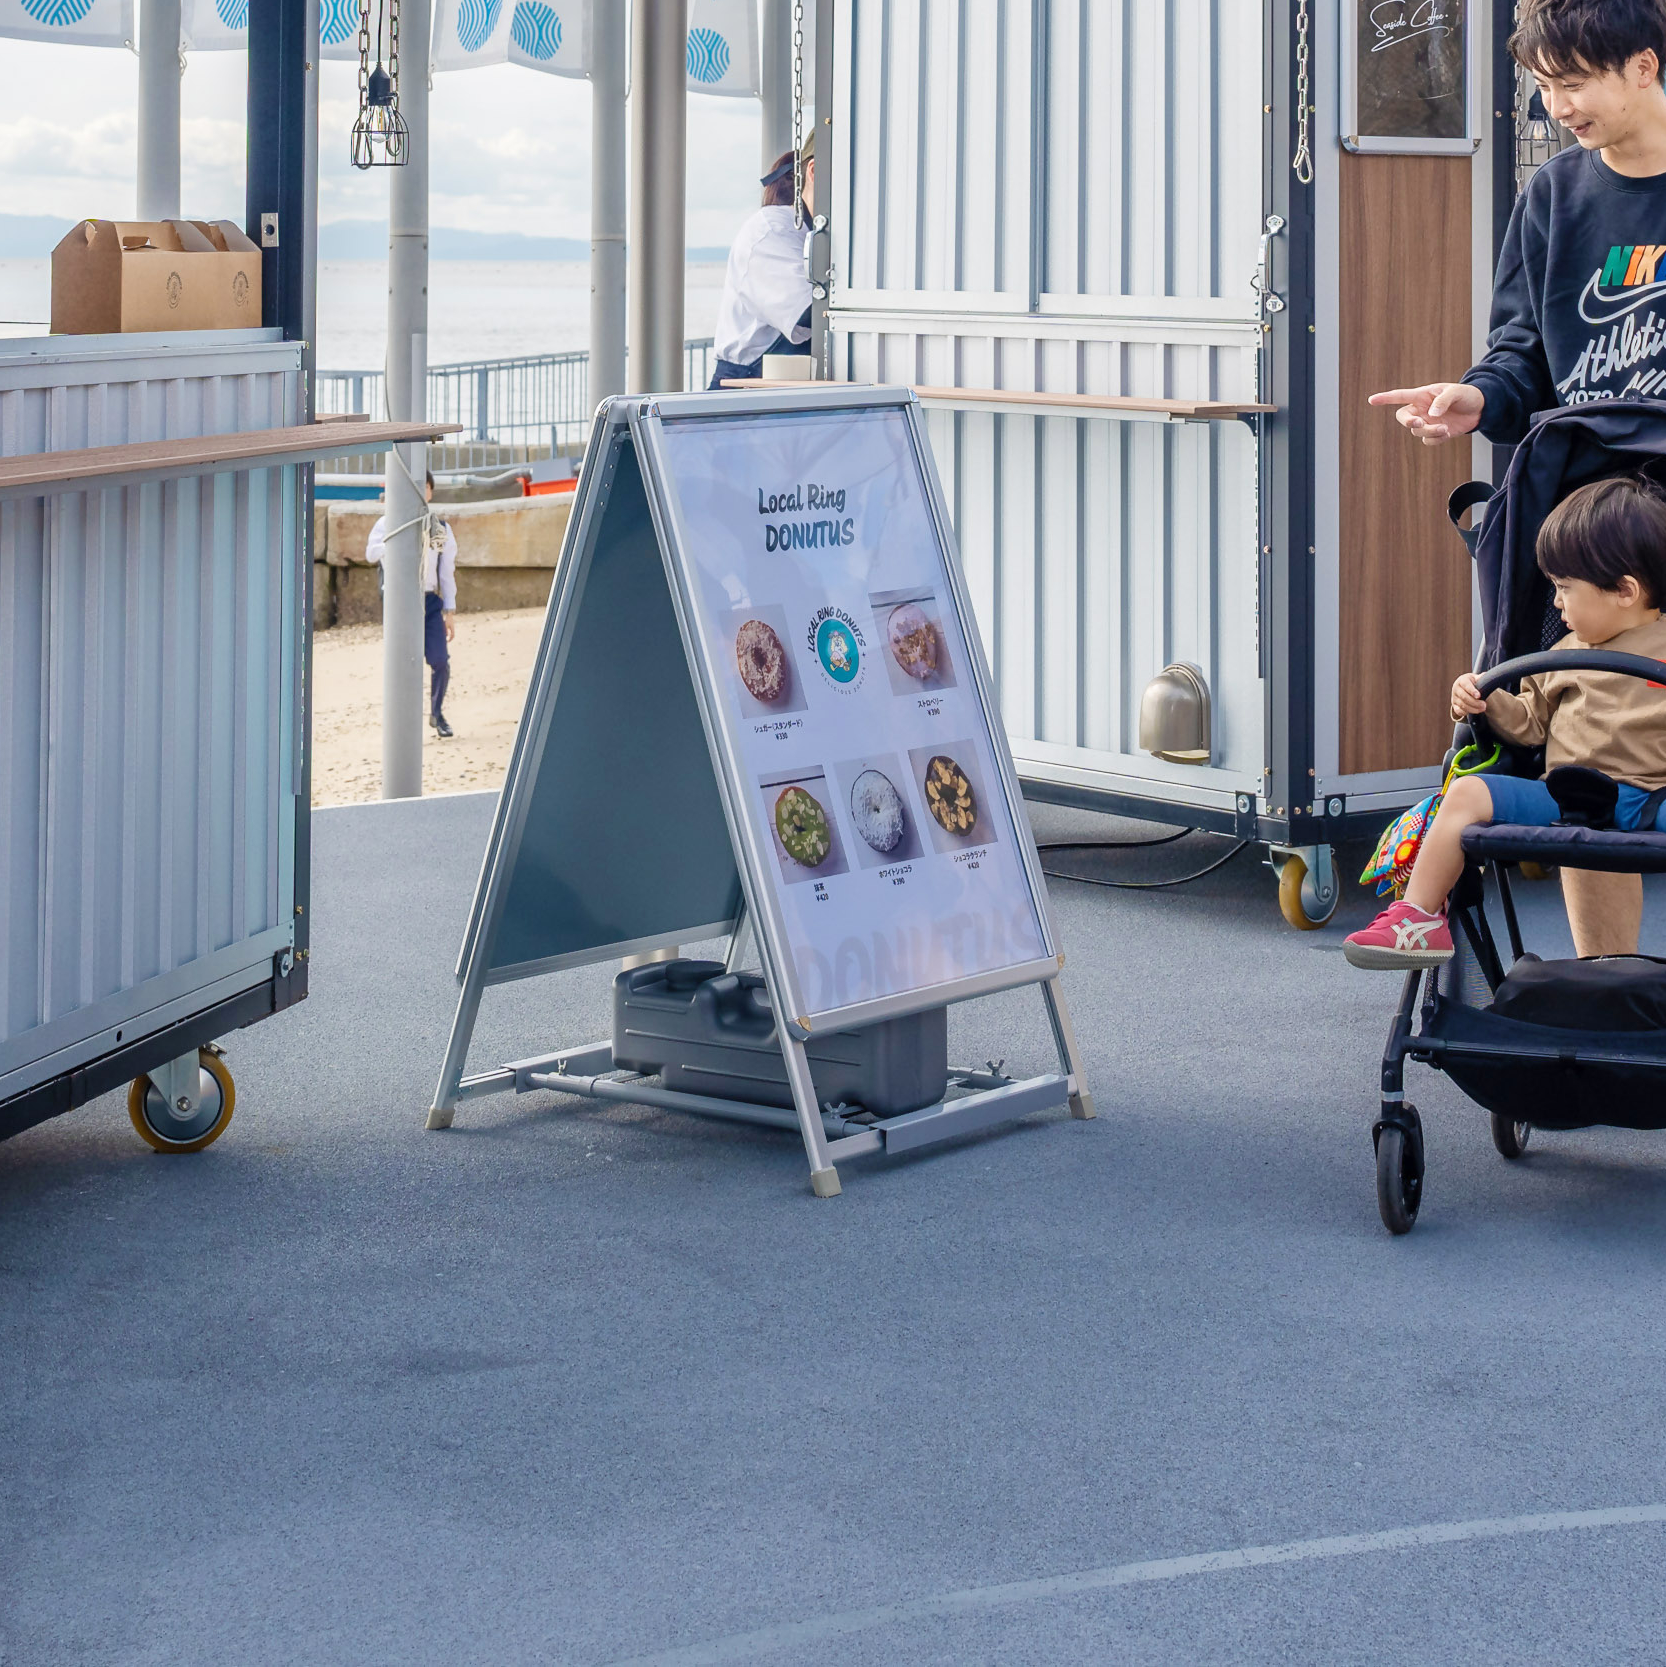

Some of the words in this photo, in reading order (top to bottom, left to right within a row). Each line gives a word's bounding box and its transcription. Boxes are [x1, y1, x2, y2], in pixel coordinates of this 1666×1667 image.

[1370, 0, 1407, 37] Seaside
[758, 484, 805, 515] Local
[807, 483, 846, 514] Ring
[765, 517, 855, 552] DONUTUS
[807, 617, 820, 653] LOCAL
[817, 605, 835, 623] RING
[835, 607, 867, 648] DONUTS
[917, 697, 944, 708] ストロベリー
[927, 707, 941, 716] ¥390
[775, 732, 788, 741] ¥330
[953, 849, 988, 864] ショコラクランチ
[878, 864, 913, 879] ホワイトショコラ
[816, 893, 829, 902] ¥420
